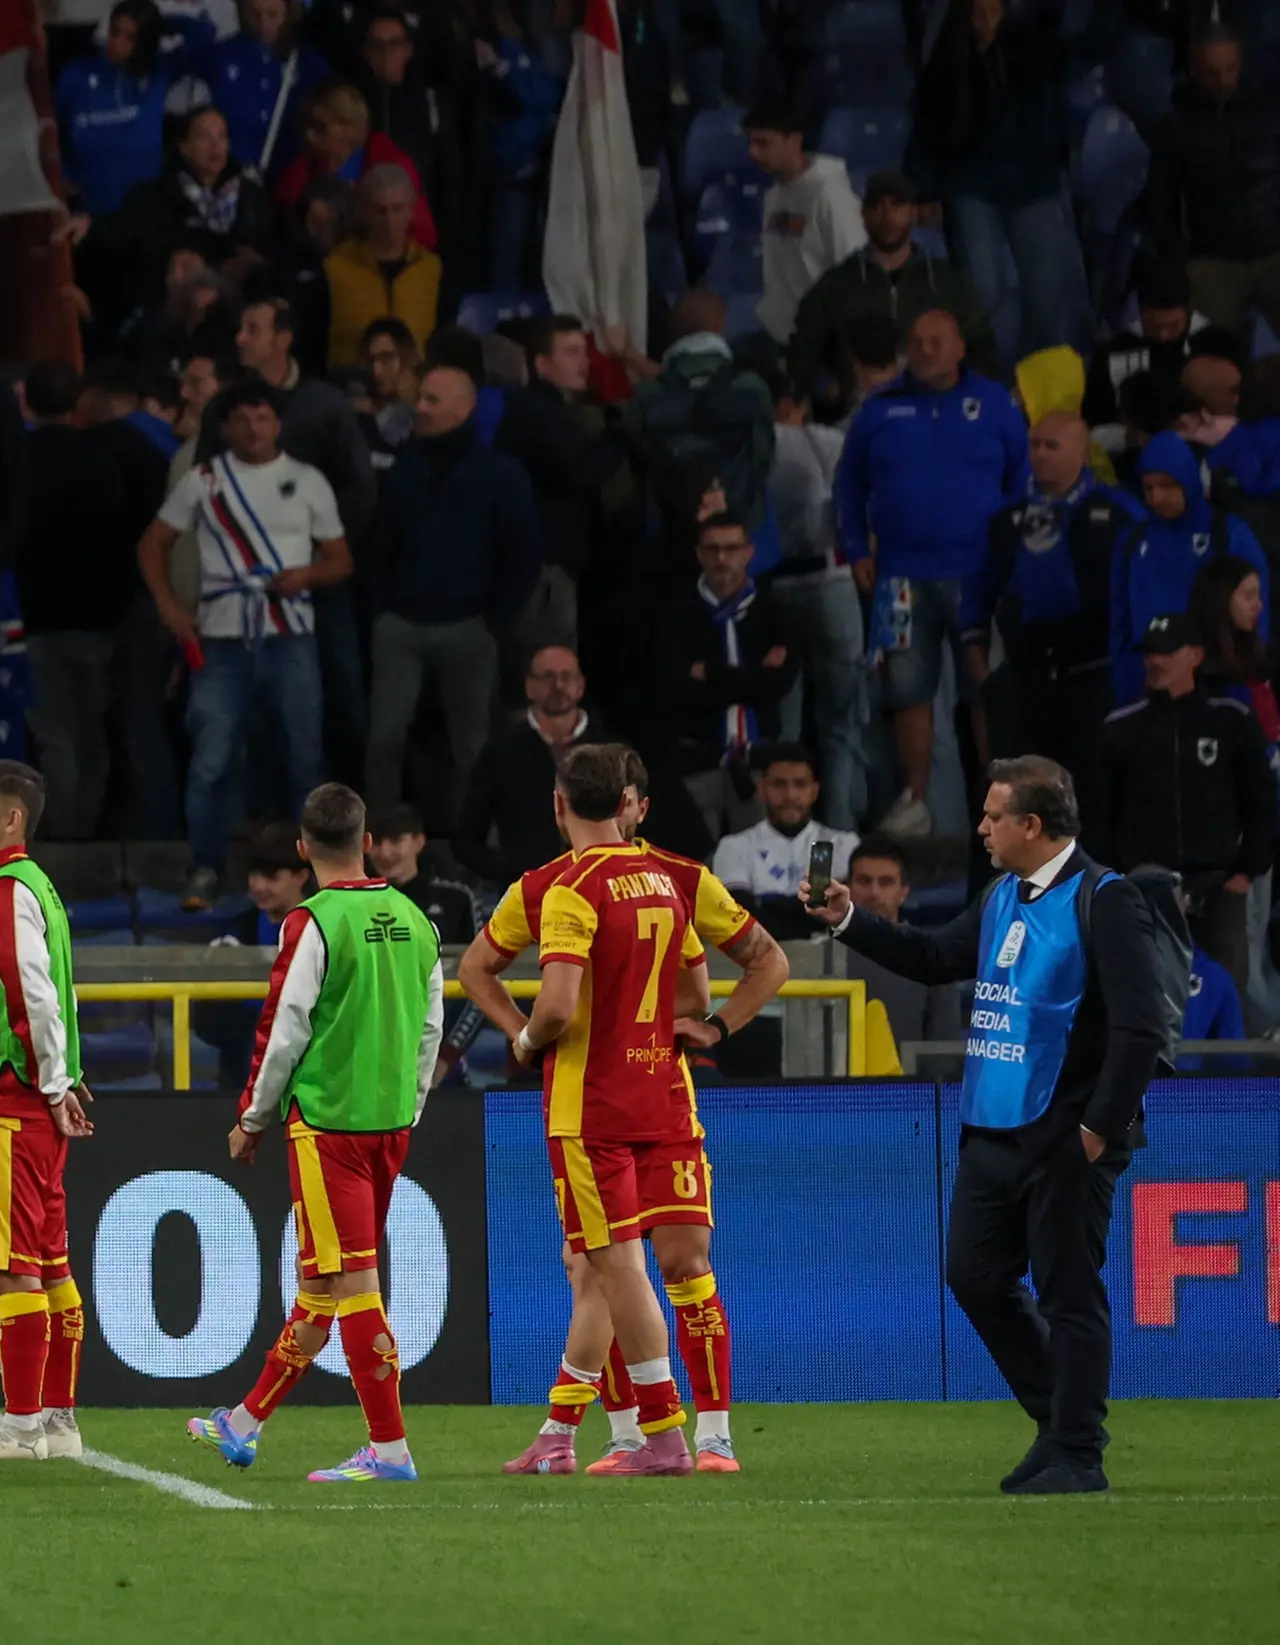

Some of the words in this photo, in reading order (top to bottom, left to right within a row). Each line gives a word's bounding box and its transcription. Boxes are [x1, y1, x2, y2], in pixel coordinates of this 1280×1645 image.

[635, 907, 675, 1023] 7
[974, 981, 1022, 1006] SOCIAL
[965, 1037, 1026, 1064] ANAGER
